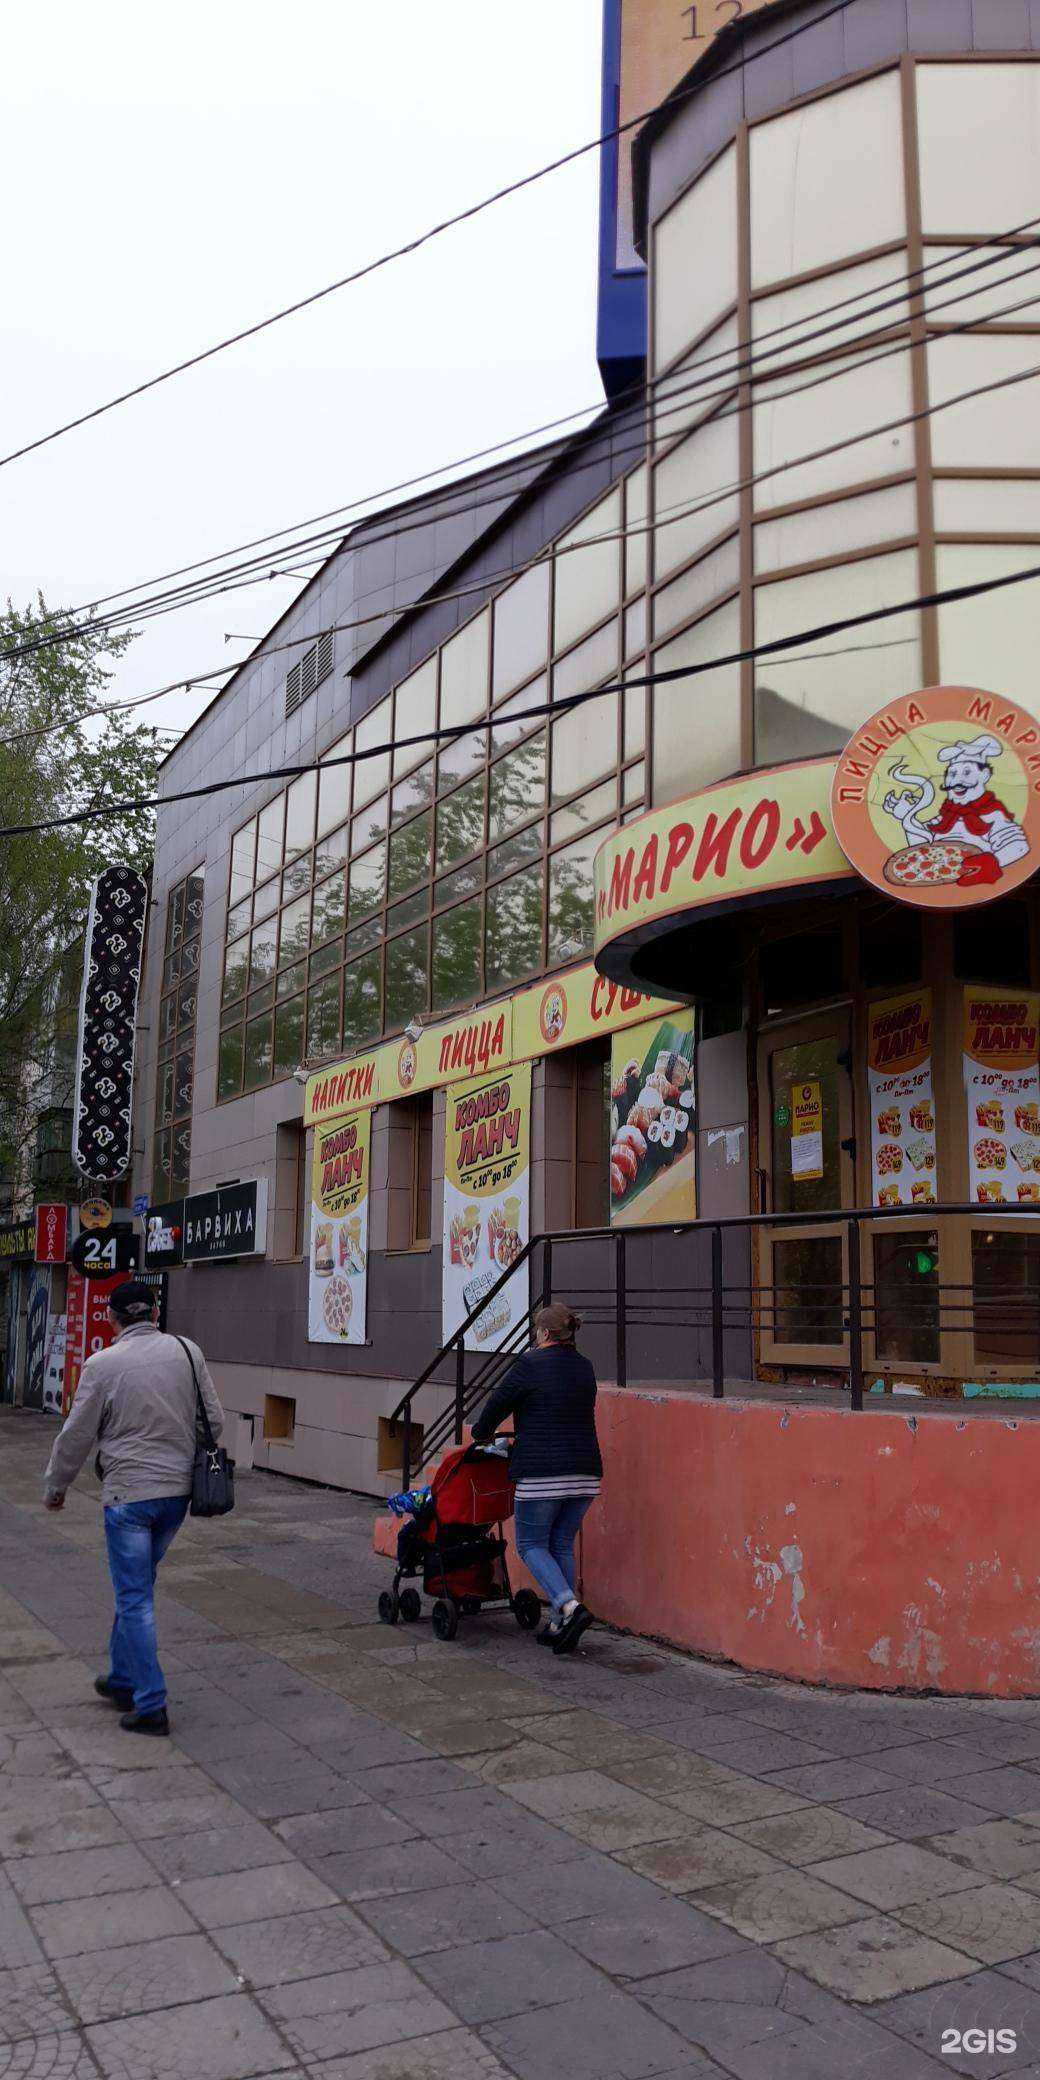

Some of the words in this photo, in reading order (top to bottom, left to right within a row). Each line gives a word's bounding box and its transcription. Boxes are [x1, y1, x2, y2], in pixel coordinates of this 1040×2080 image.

[839, 700, 926, 804] ПИЦЦА
[312, 1061, 376, 1114] НАПИТКИ
[438, 1013, 504, 1075] ПИЦЦА
[590, 976, 651, 1022] СУШ
[875, 1018, 930, 1066] ЛАНЧ
[971, 1026, 1037, 1050] ЛАНЧ
[454, 1082, 511, 1132] КОМБО
[320, 1124, 357, 1164] КОМБО
[456, 1108, 521, 1171] ЛАНЧ
[320, 1146, 364, 1196] ЛАНЧ
[186, 1207, 254, 1244] БАРВИХА
[84, 1238, 117, 1269] 24
